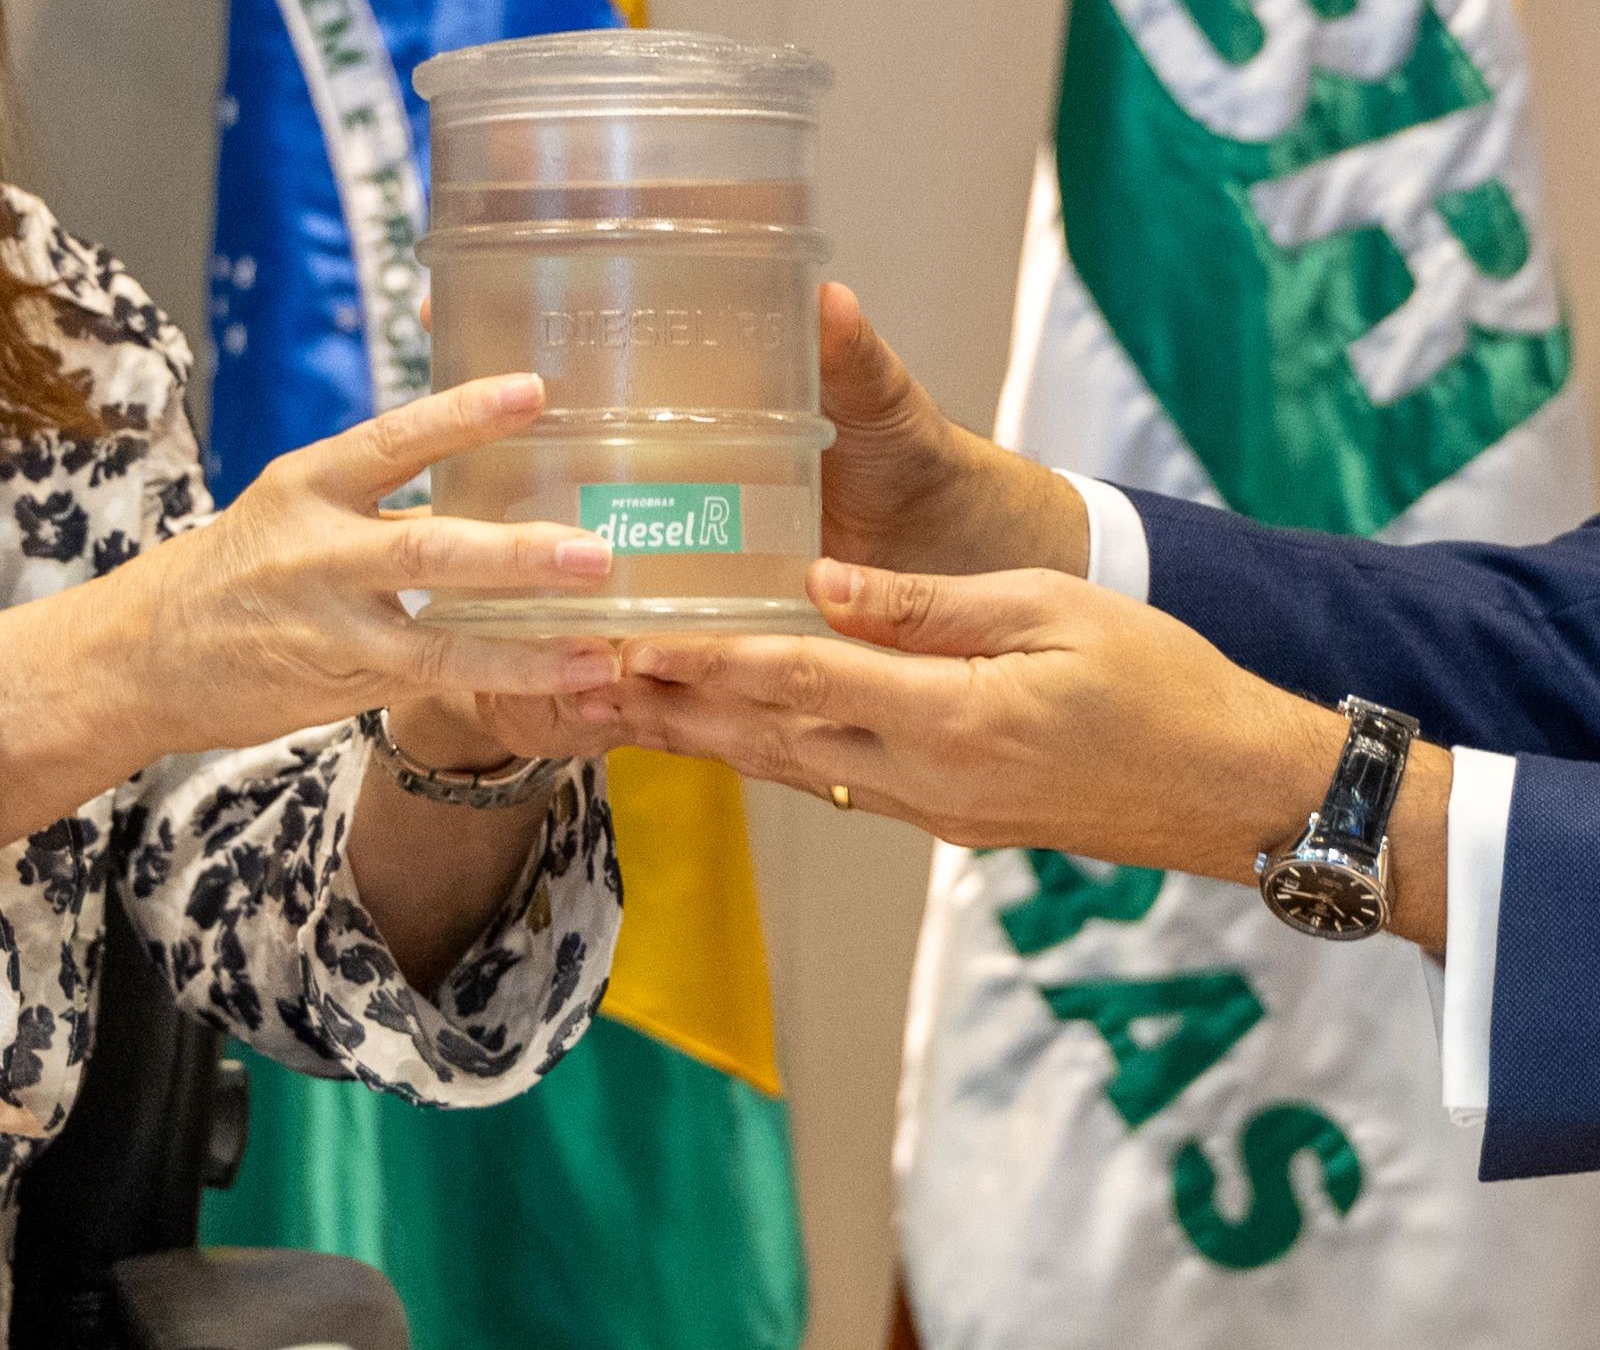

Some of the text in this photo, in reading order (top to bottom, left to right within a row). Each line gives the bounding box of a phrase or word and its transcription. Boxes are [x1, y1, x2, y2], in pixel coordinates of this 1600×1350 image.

[540, 308, 719, 348] DIESEL
[611, 497, 676, 509] PETROBRAS
[595, 510, 695, 549] diesel
